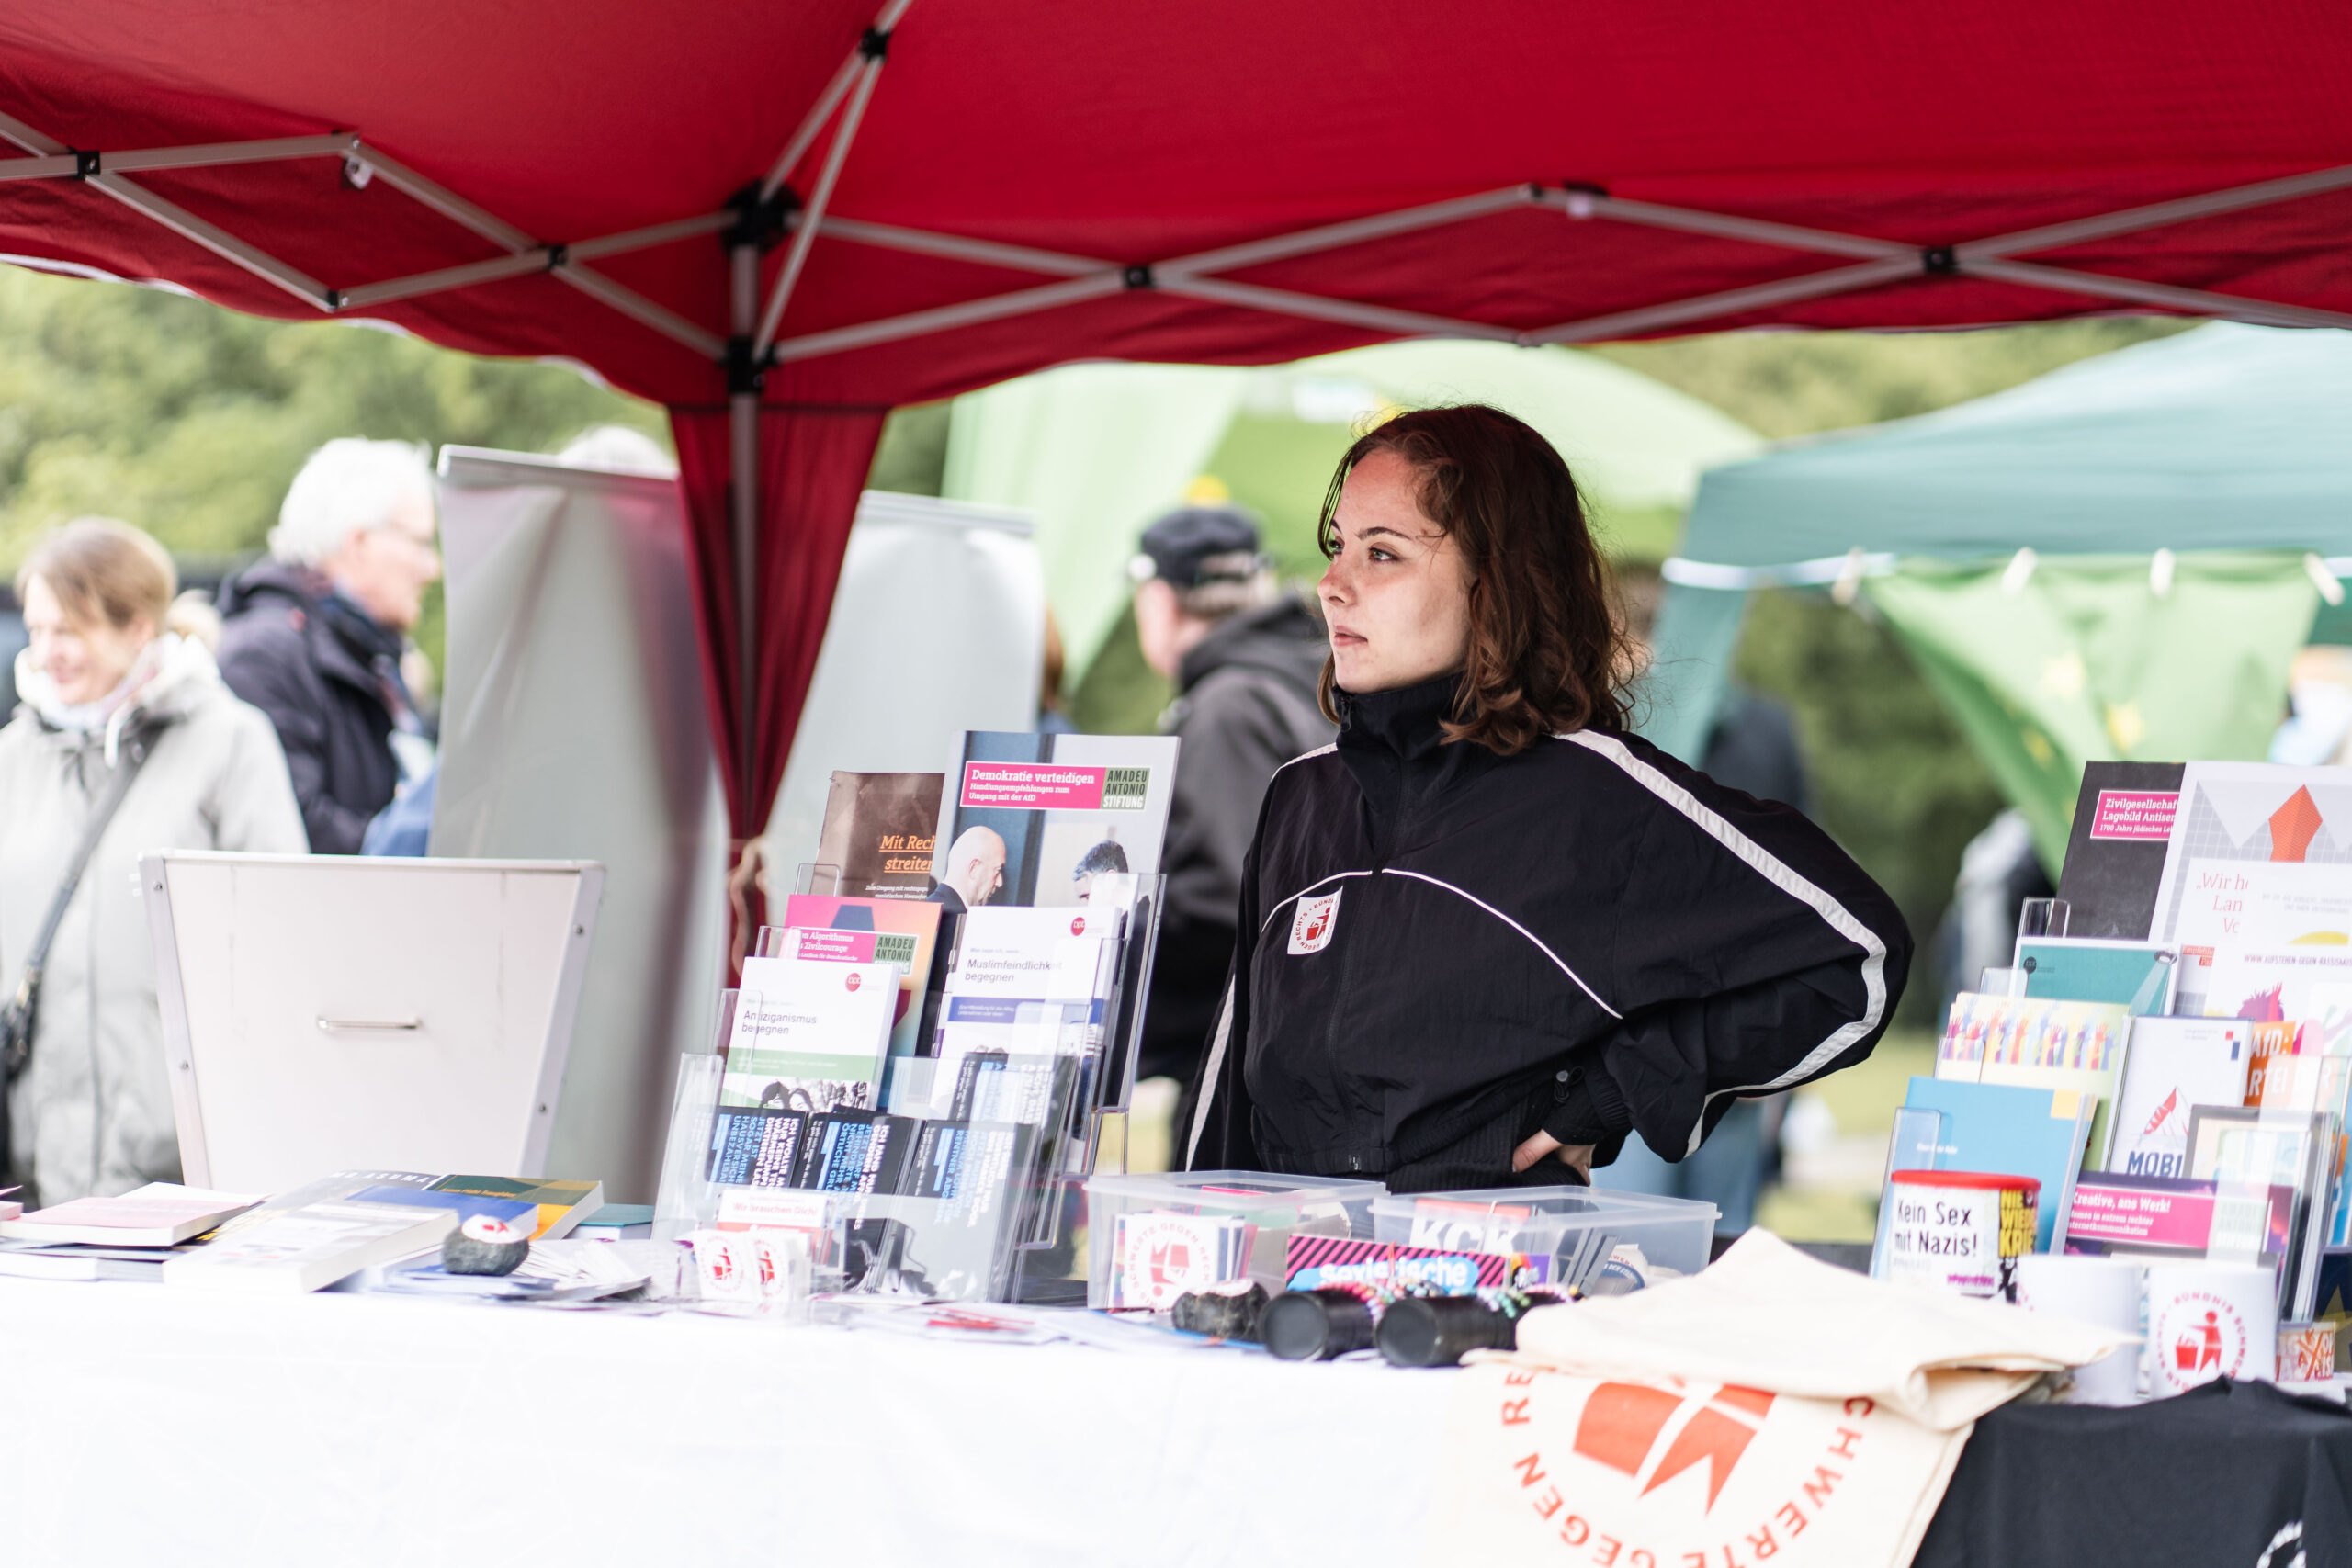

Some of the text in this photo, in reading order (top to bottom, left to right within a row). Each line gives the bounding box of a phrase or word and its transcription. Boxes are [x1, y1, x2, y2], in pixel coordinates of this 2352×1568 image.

[969, 783, 1054, 794] Handlungsempfehlungen
[971, 769, 1095, 786] Demokratie verteidigen
[1106, 770, 1148, 783] AMADEU
[968, 792, 1036, 802] Umgang mit der AfD
[1104, 783, 1146, 795] ANTONIO
[1102, 795, 1144, 808] STIFTUNG
[2105, 797, 2178, 810] Zivilgesellschaf
[2102, 810, 2142, 823] Lagebild
[2115, 824, 2133, 832] Jahre
[2133, 825, 2162, 834] jüdisches
[879, 835, 905, 850] Mit
[809, 931, 854, 942] Algorithmus
[1295, 912, 1308, 942] RECHTS
[805, 942, 849, 953] Zivilcourage
[875, 948, 912, 962] ANTONIO
[876, 937, 914, 950] AMADEU
[965, 971, 1014, 983] begegnen
[743, 1010, 817, 1025] Aniziganismus
[2251, 1029, 2290, 1058] AfD:
[749, 1116, 765, 1158] JETZT IST
[779, 1118, 790, 1139] NUR
[842, 1123, 857, 1153] NICHT
[859, 1124, 873, 1151] JETZT
[877, 1124, 888, 1142] ICH
[726, 1115, 750, 1182] HAUSVERSICH
[734, 1116, 758, 1183] SOGAR MEINE
[755, 1117, 774, 1166] DIKTIEREN
[775, 1119, 797, 1186] ICH WOLLTE M
[830, 1122, 851, 1168] ÖRTLICHE
[842, 1123, 865, 1181] BEHINDERTE
[861, 1124, 881, 1172] GENDERN
[945, 1129, 963, 1174] RENTNER
[771, 1142, 784, 1170] KEINE
[852, 1152, 865, 1179] DARF
[869, 1144, 883, 1172] FAND
[823, 1169, 838, 1190] GRU
[834, 1154, 849, 1183] MEHR
[1897, 1198, 1972, 1227] Kein Sex
[2117, 1197, 2138, 1210] ans
[2140, 1197, 2172, 1213] Werk!
[1160, 1223, 1199, 1243] GEGEN
[1198, 1246, 1211, 1282] RECH
[1894, 1230, 1977, 1258] mit Nazis!
